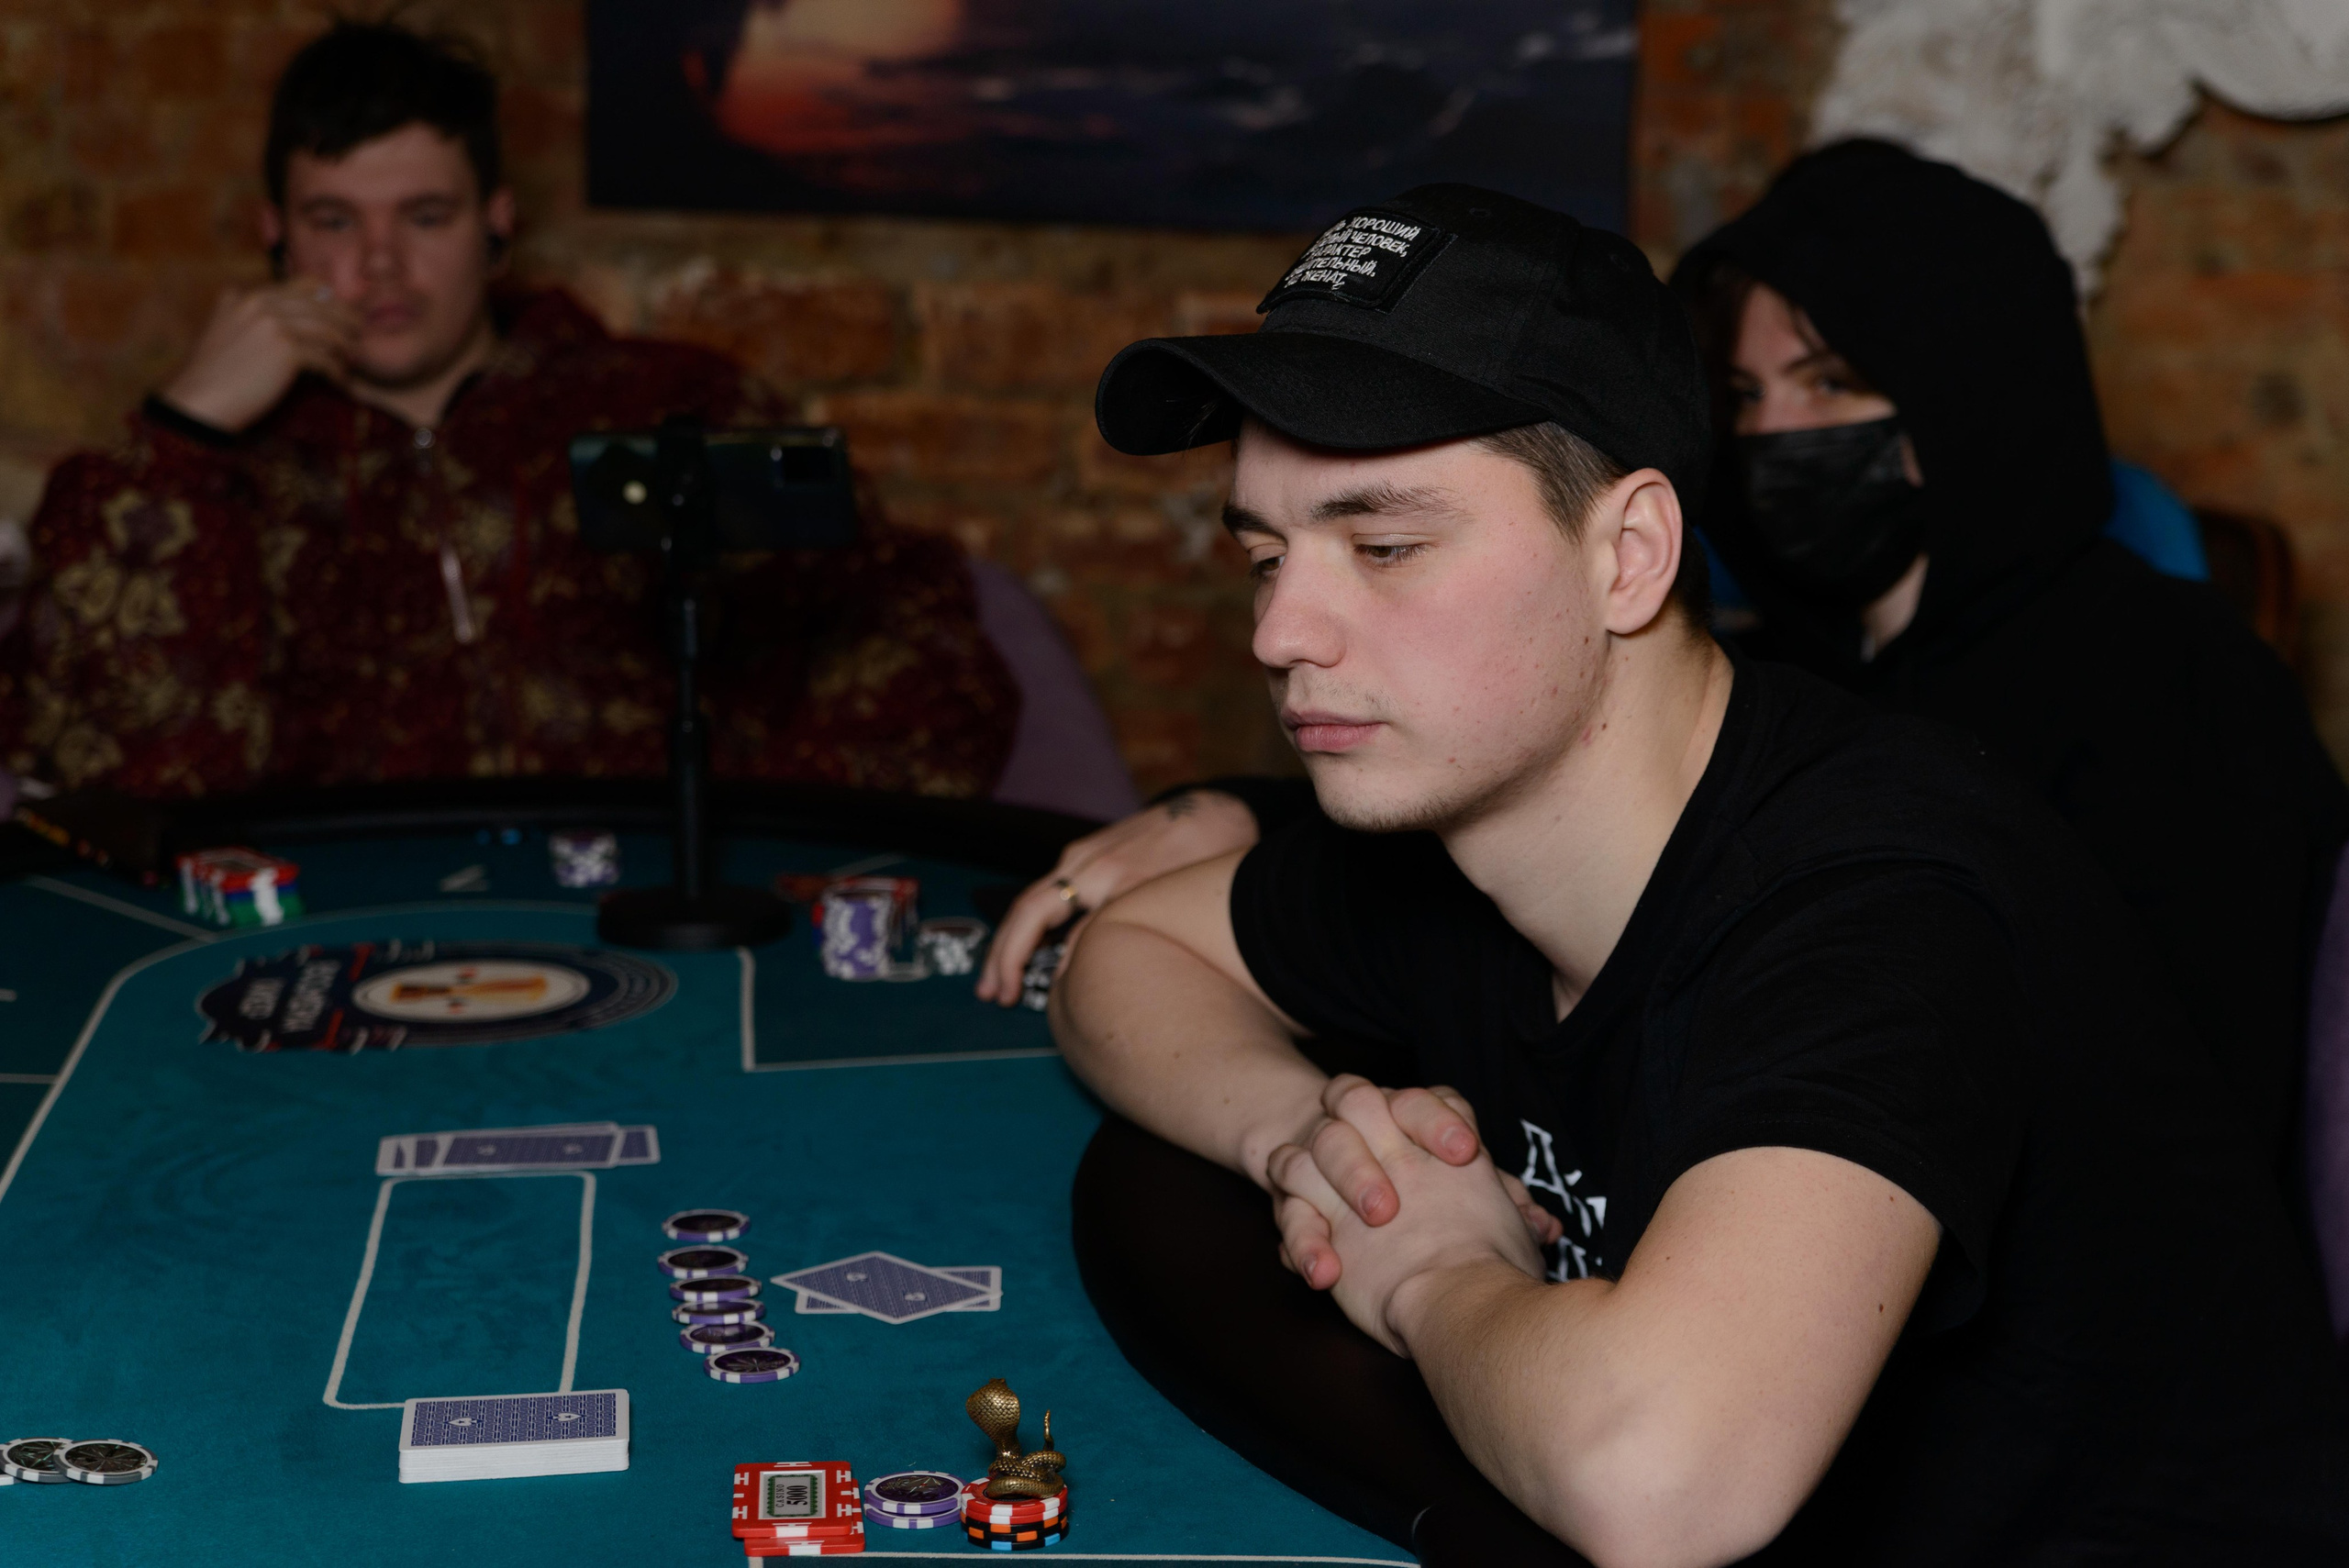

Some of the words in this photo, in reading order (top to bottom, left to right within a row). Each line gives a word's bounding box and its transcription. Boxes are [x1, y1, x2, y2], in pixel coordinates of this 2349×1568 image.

[1346, 217, 1421, 241] ХОРОШИЙ
[1351, 230, 1410, 258] ЧЕЛОВЕК,
[775, 1484, 785, 1507] CASINO
[786, 1485, 808, 1506] 5000
